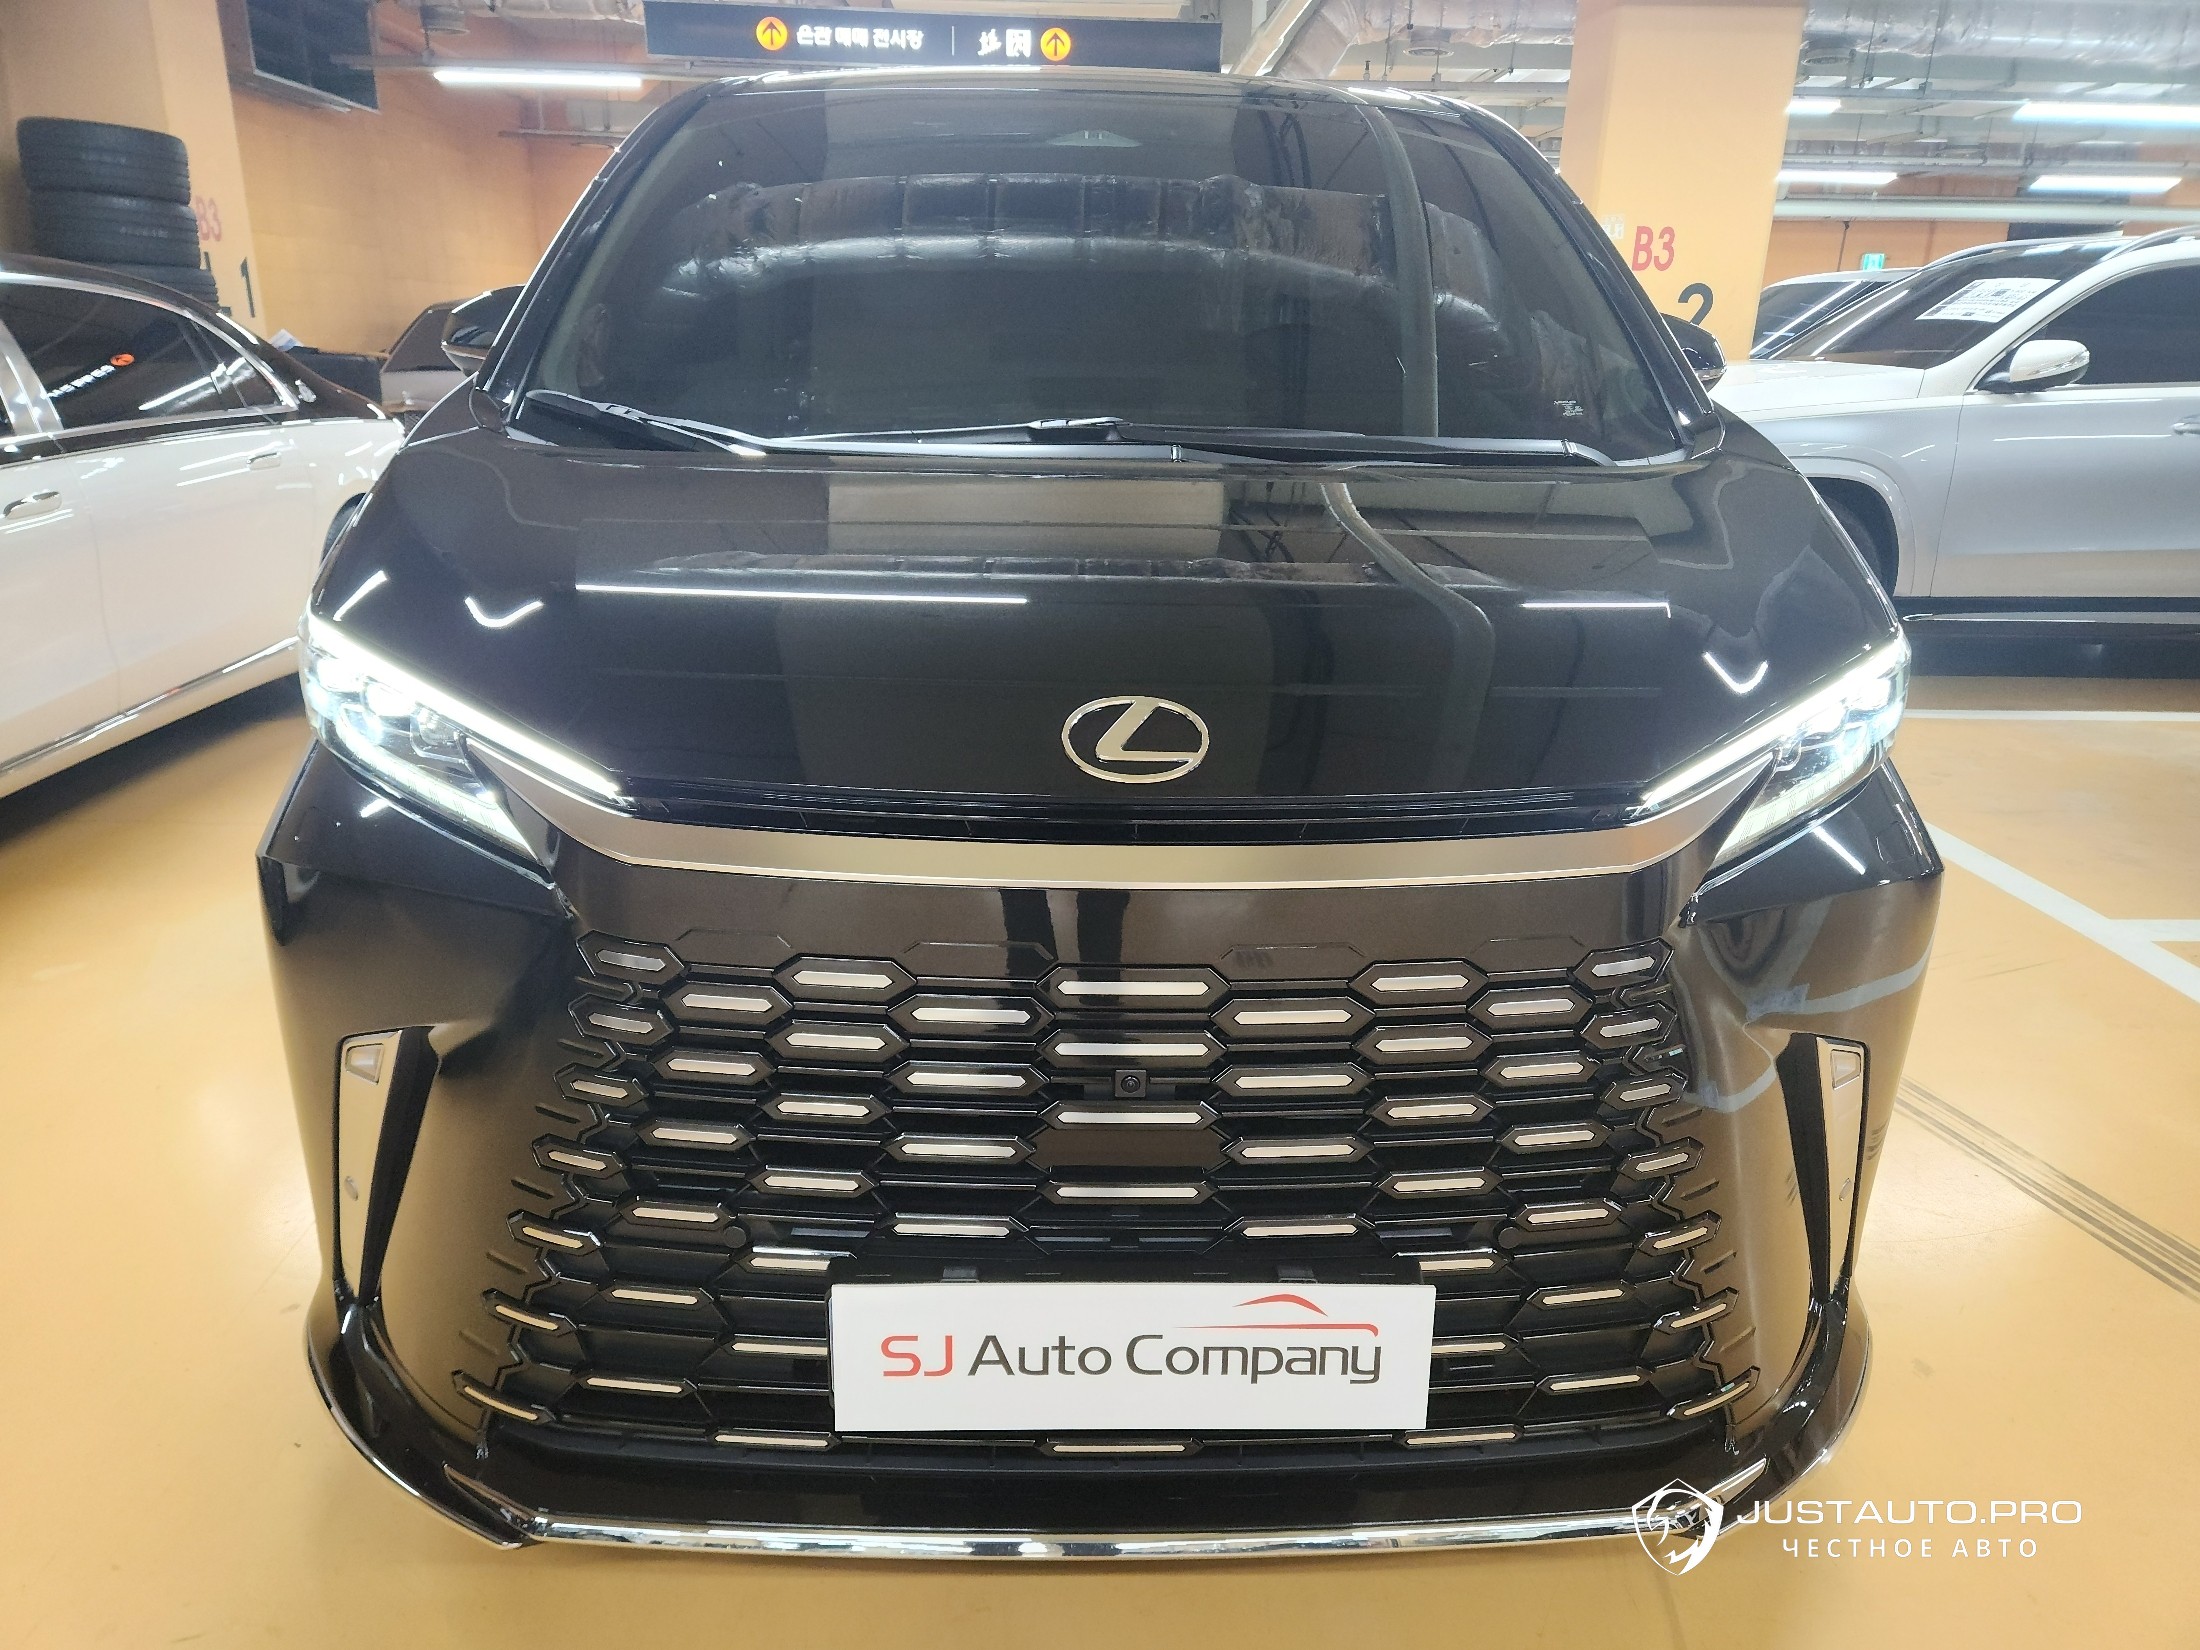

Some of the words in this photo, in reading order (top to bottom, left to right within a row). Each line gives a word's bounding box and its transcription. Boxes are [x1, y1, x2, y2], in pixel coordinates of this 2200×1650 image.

[872, 28, 924, 50] 전시장
[1632, 225, 1675, 271] B3
[880, 1335, 954, 1377] SJ
[967, 1335, 1113, 1377] Auto
[1126, 1334, 1382, 1384] Company
